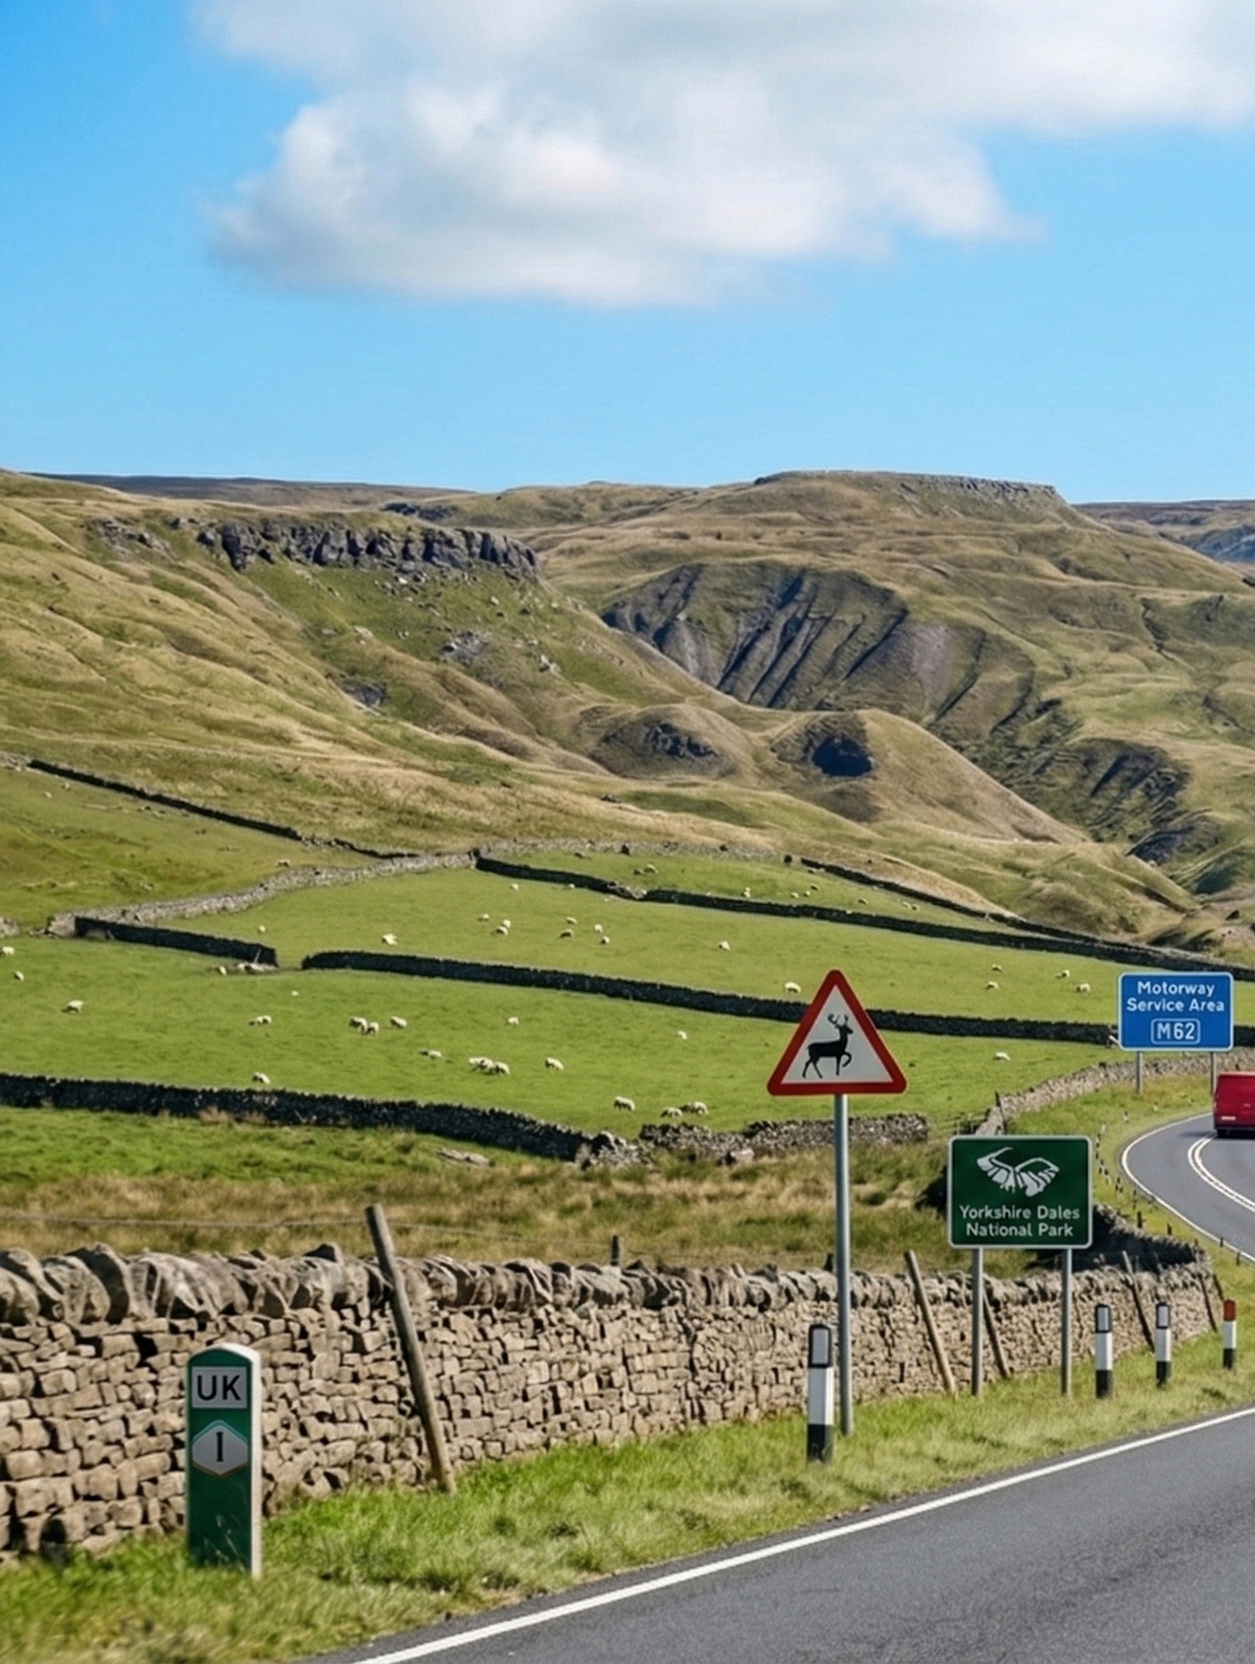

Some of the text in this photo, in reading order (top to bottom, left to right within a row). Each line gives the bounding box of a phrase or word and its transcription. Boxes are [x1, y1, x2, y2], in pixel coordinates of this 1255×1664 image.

[1137, 981, 1215, 997] Motorway
[1126, 997, 1225, 1012] Service Area
[1156, 1024, 1196, 1041] M62
[959, 1204, 1081, 1220] Yorkshire Dales
[966, 1221, 1074, 1237] National Park
[197, 1374, 242, 1401] UK
